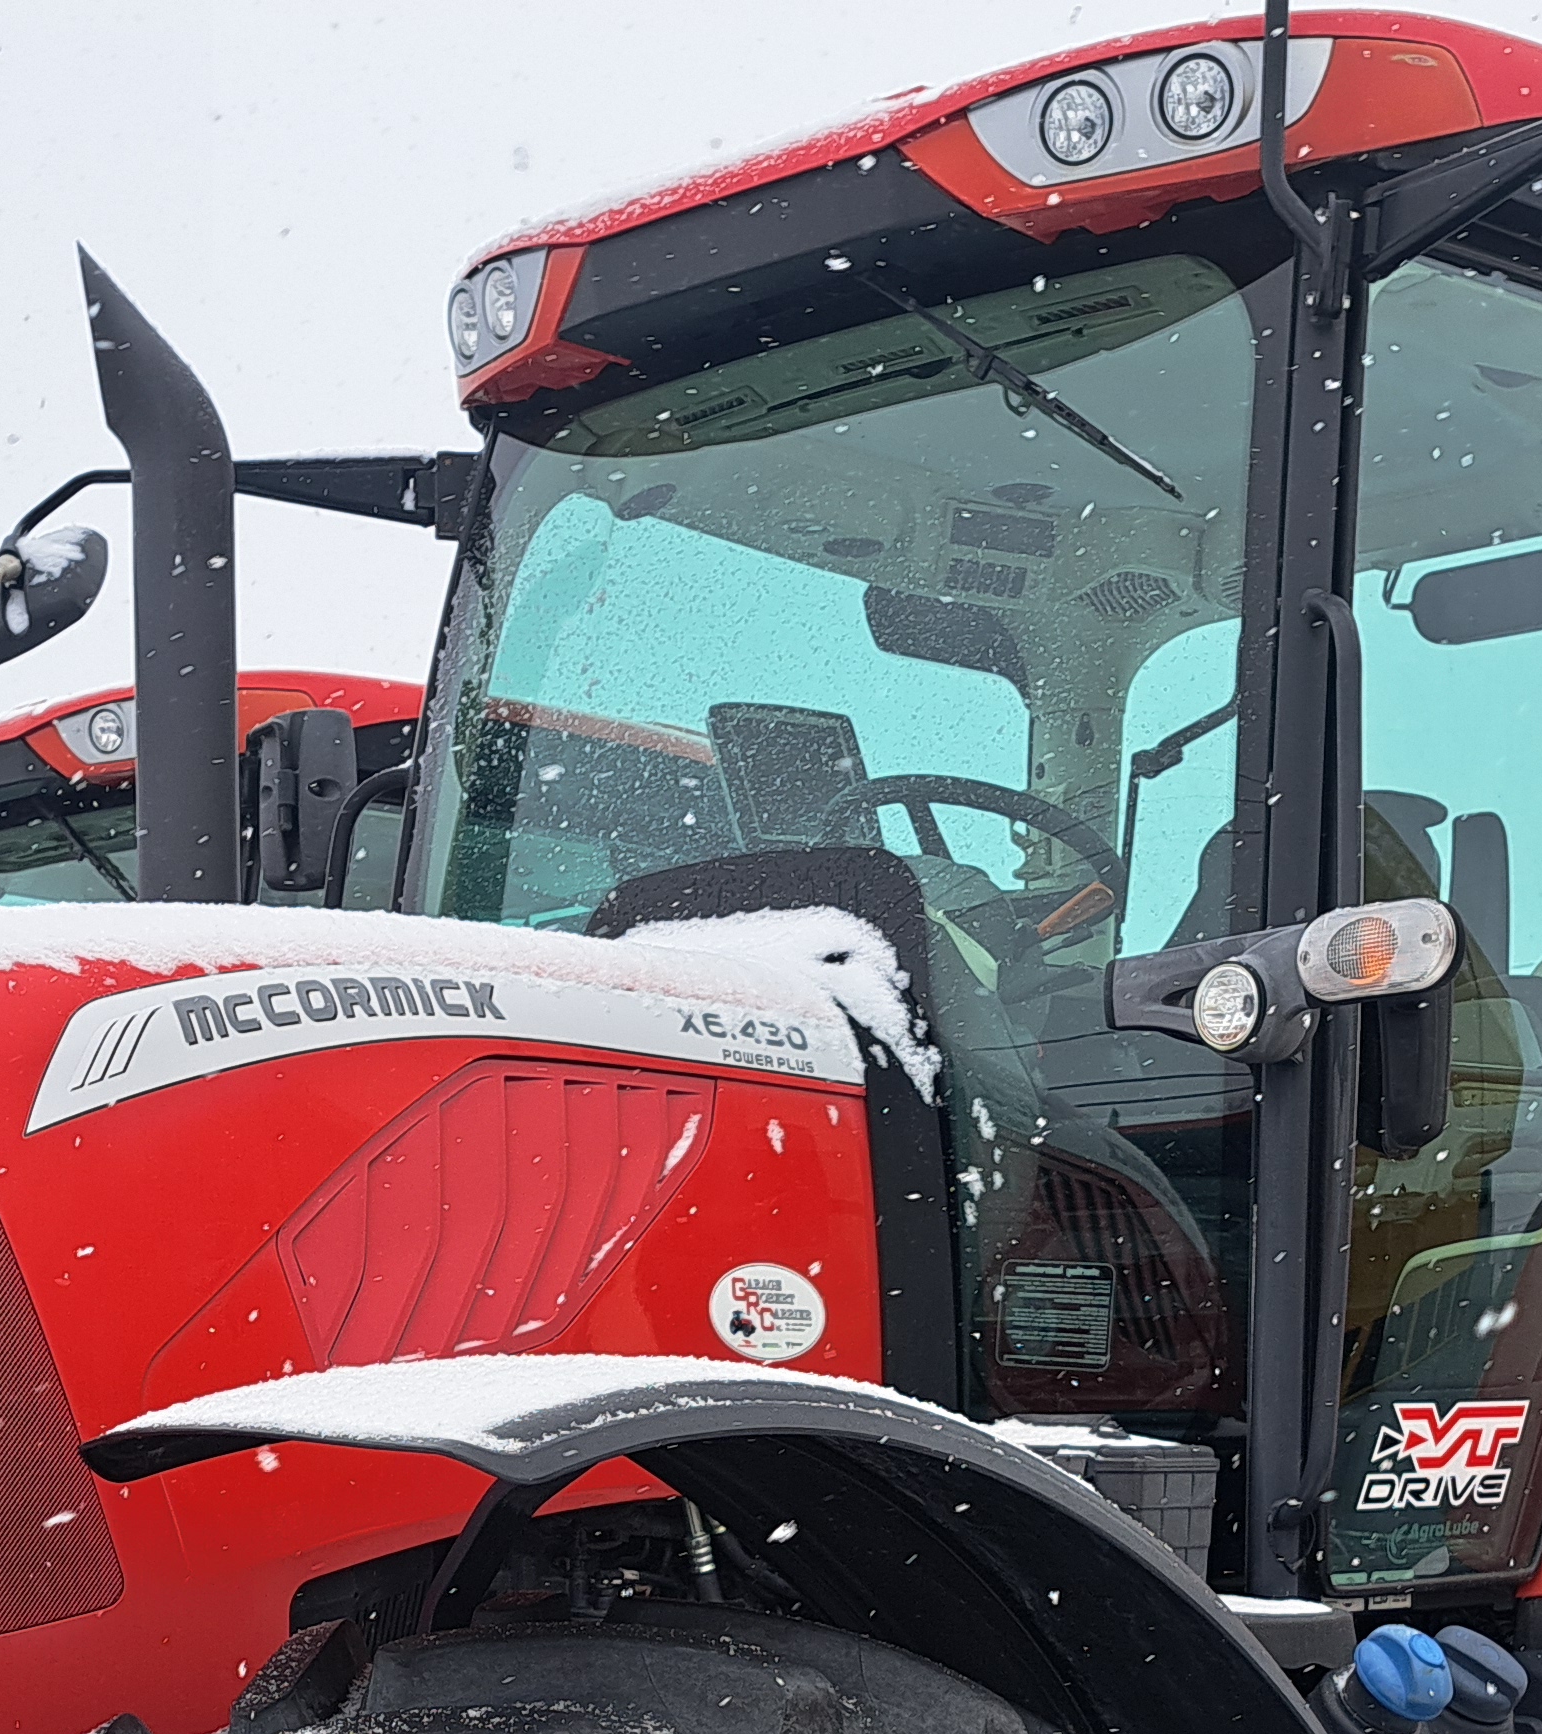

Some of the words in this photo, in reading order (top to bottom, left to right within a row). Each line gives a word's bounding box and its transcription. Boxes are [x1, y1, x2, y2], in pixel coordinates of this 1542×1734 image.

[721, 1049, 774, 1068] POWER
[776, 1056, 815, 1073] PLUS
[1359, 1471, 1509, 1508] DRIVE
